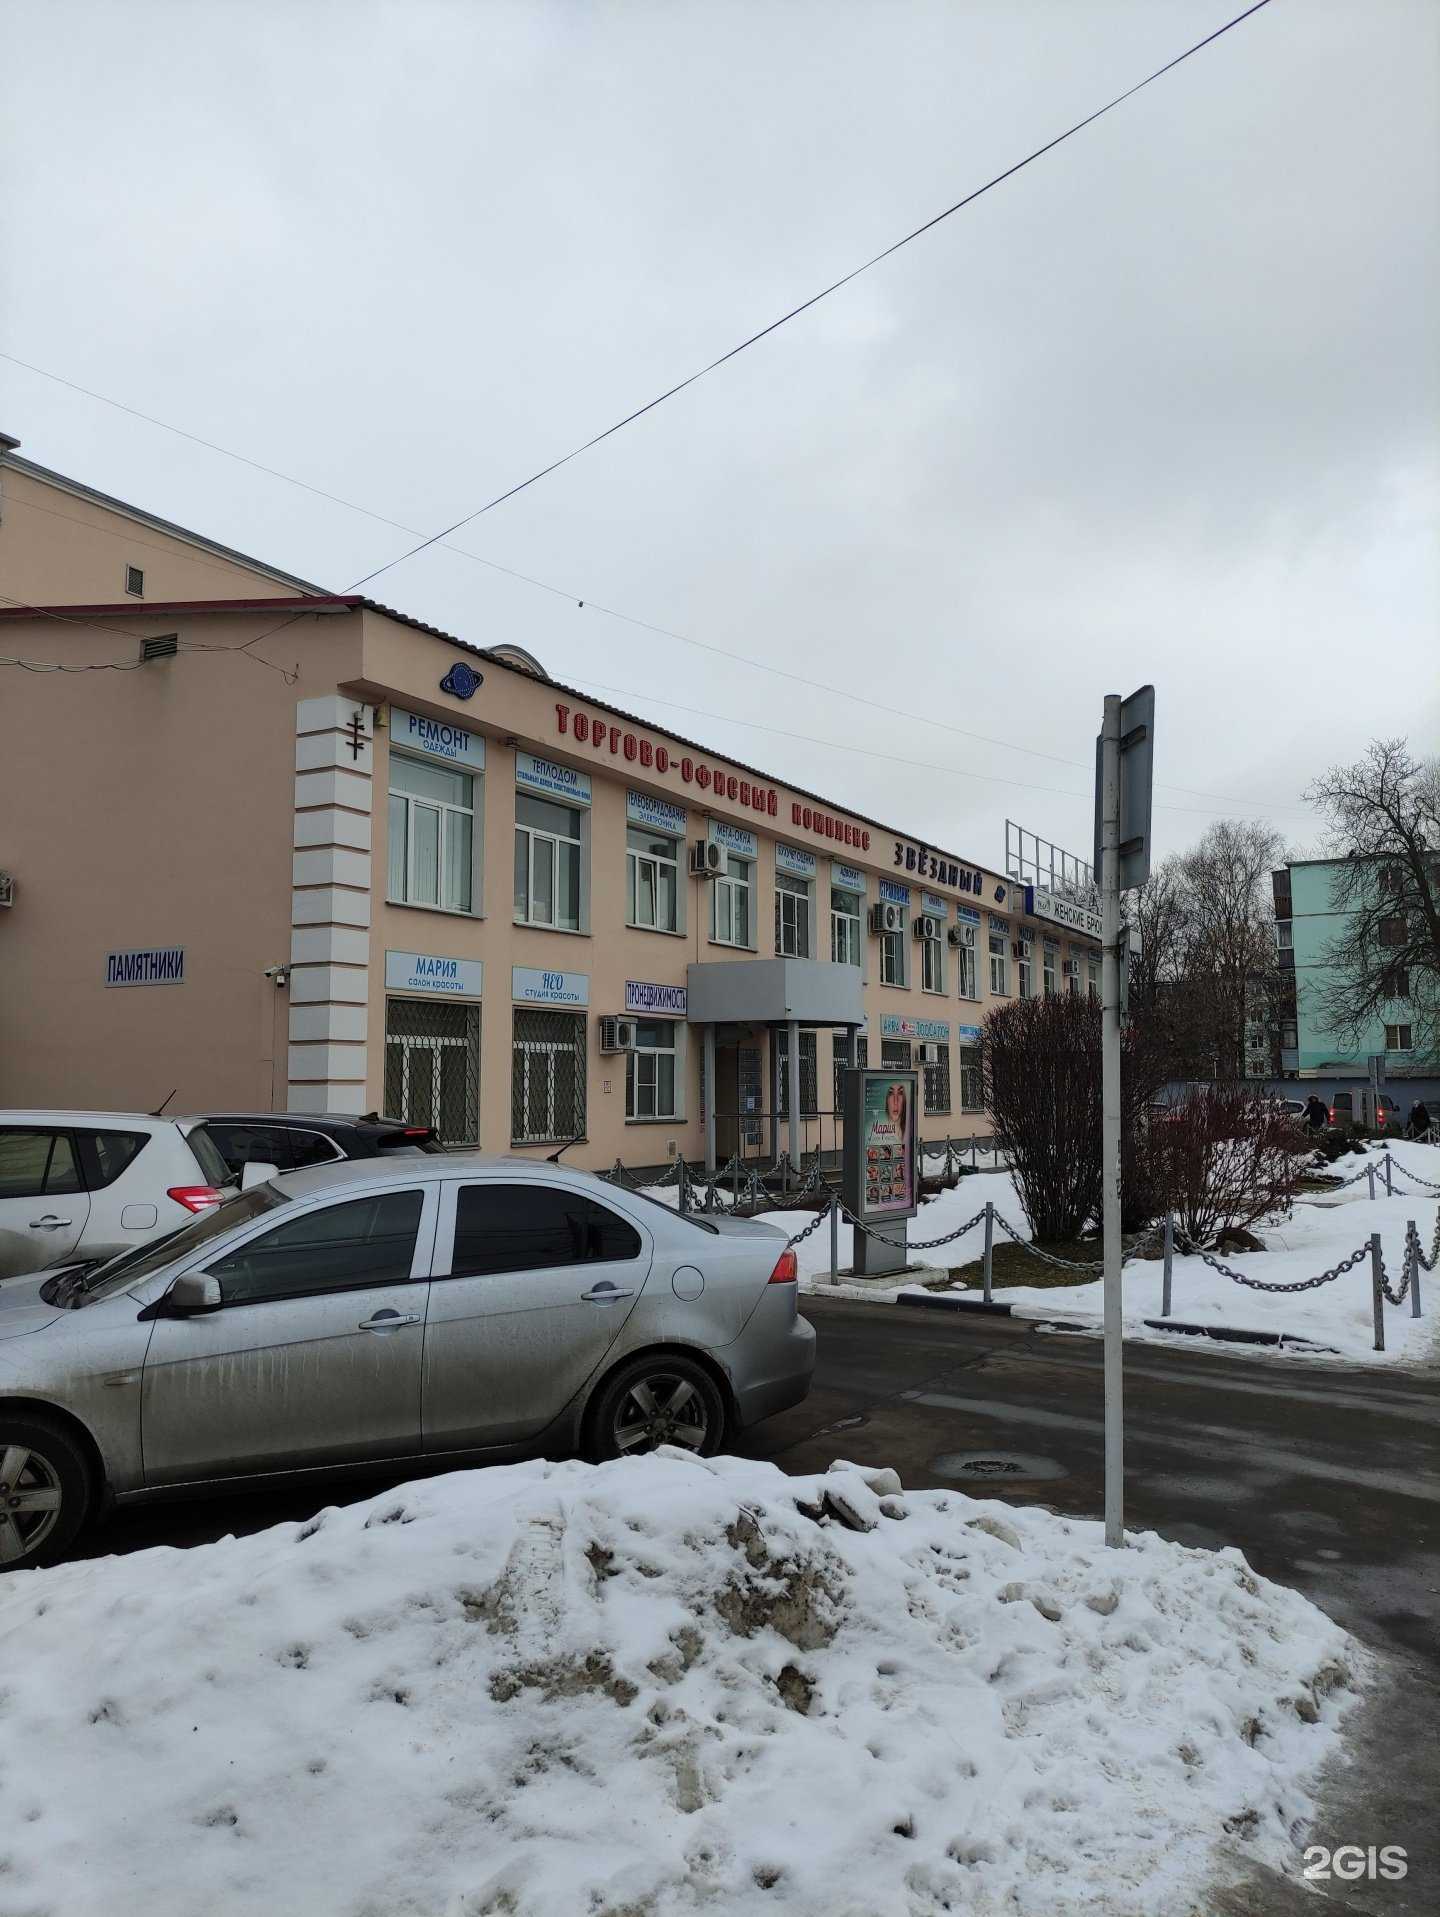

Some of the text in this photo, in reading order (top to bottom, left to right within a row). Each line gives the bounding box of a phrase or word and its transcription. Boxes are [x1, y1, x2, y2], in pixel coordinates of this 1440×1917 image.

[409, 715, 470, 751] РЕМОНТ
[423, 739, 457, 758] ОДЕЖДЫ
[532, 759, 577, 785] ТЕПЛОДОМ
[556, 704, 983, 896] ТОРГОВО-ОФИСНЫЙ КОМПЛЕКС ЗВЁЗДНЫЙ
[638, 810, 677, 831] ЭЛЕКТРОНИКА
[716, 823, 751, 844] МЕГА-ОКНА
[1053, 902, 1085, 928] ЖЕНСКИЕ
[108, 950, 184, 982] ПАМЯТНИКИ
[415, 957, 457, 978] МАРИЯ
[408, 977, 464, 991] салон красоты
[524, 988, 580, 1001] студия красоты
[627, 983, 686, 1009] ПРОНЕДВИЖИМОСТЬ
